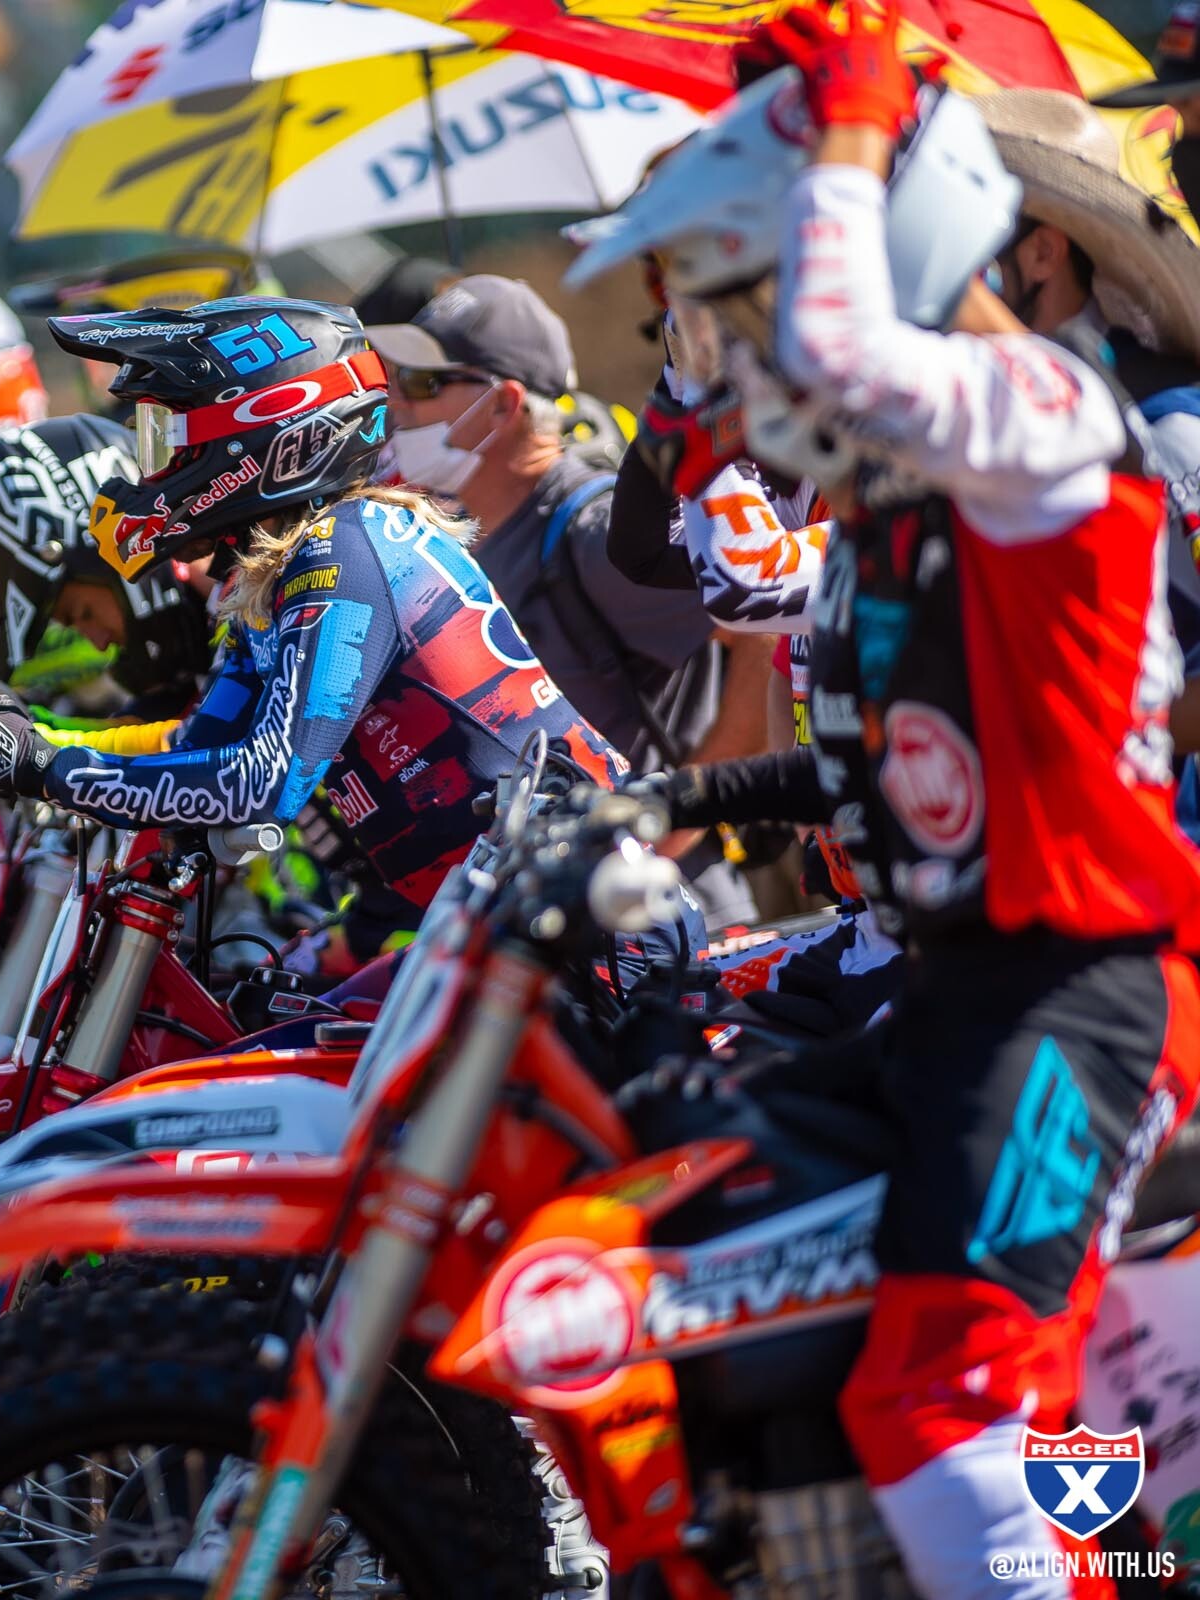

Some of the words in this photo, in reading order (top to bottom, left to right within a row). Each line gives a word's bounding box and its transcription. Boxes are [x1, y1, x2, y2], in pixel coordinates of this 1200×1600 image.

[207, 311, 317, 376] 51
[218, 454, 262, 495] Bull
[65, 766, 152, 822] Troy
[150, 771, 226, 824] Lee
